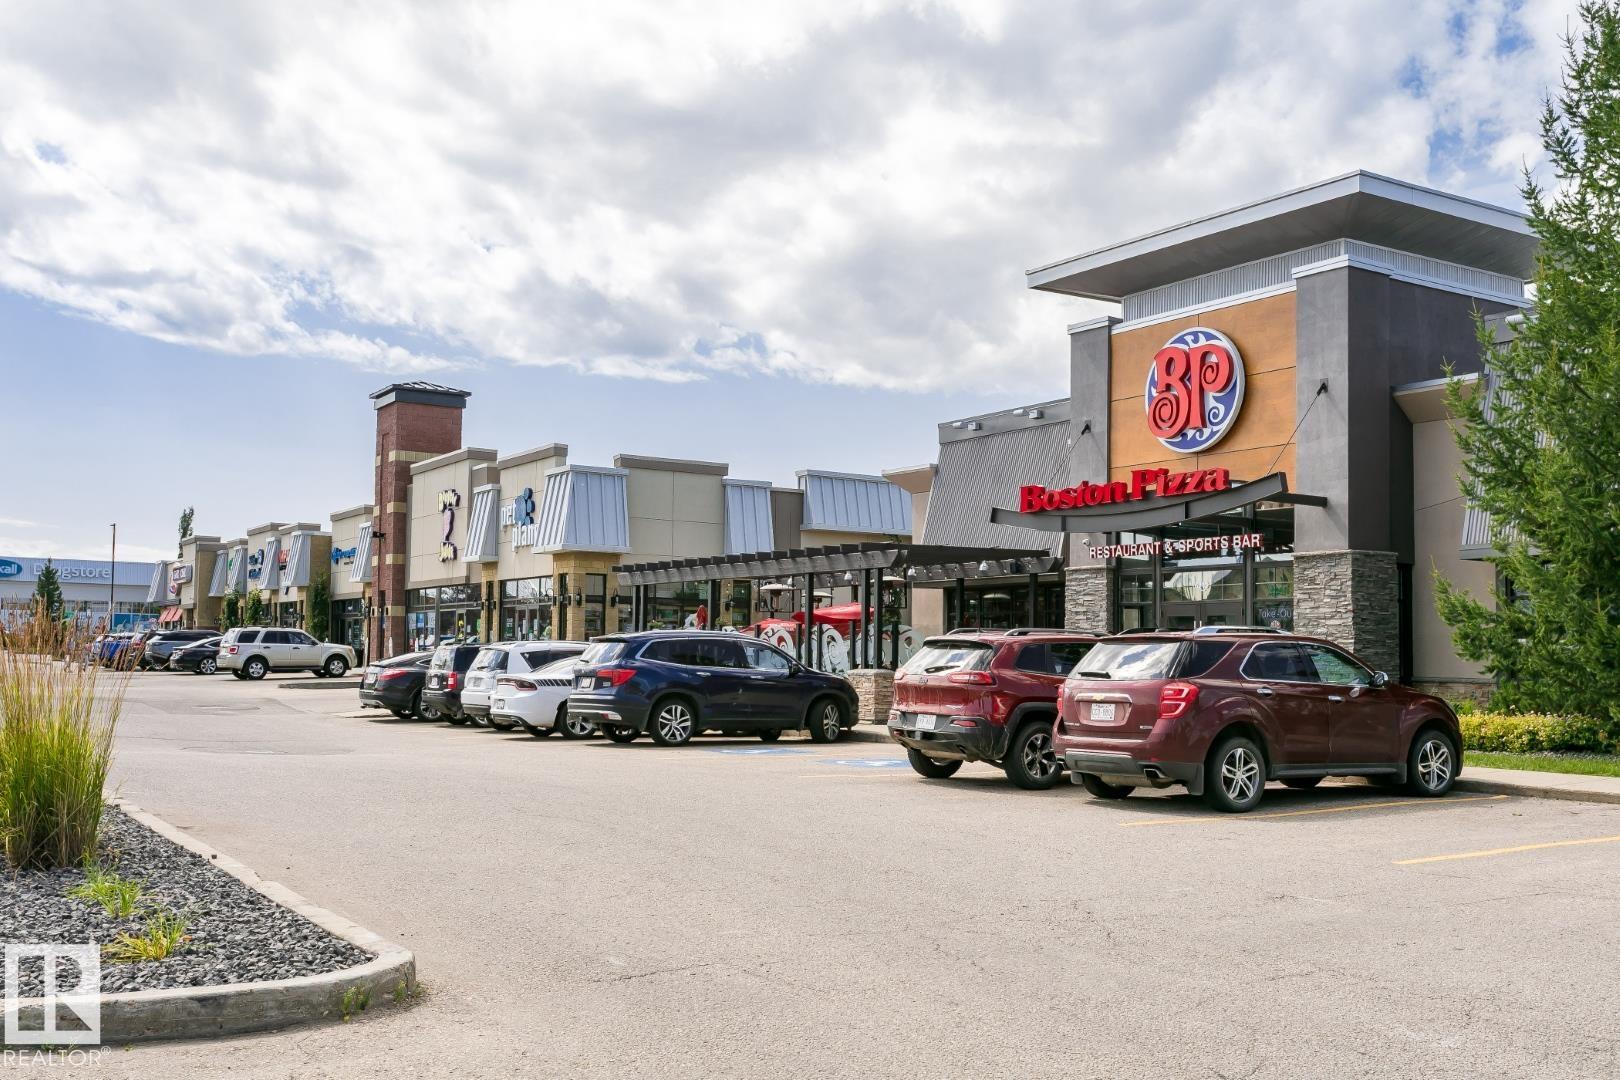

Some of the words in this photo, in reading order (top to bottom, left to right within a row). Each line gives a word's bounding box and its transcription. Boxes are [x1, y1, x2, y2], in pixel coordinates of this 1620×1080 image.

[1148, 343, 1234, 439] BP
[1019, 480, 1127, 513] Boston
[1131, 468, 1230, 500] Pizza
[1089, 541, 1161, 559] RESTAURANT
[1165, 541, 1173, 554] &
[1178, 536, 1229, 553] SPORTS
[1233, 533, 1261, 548] BAR
[33, 563, 111, 579] Dgstore
